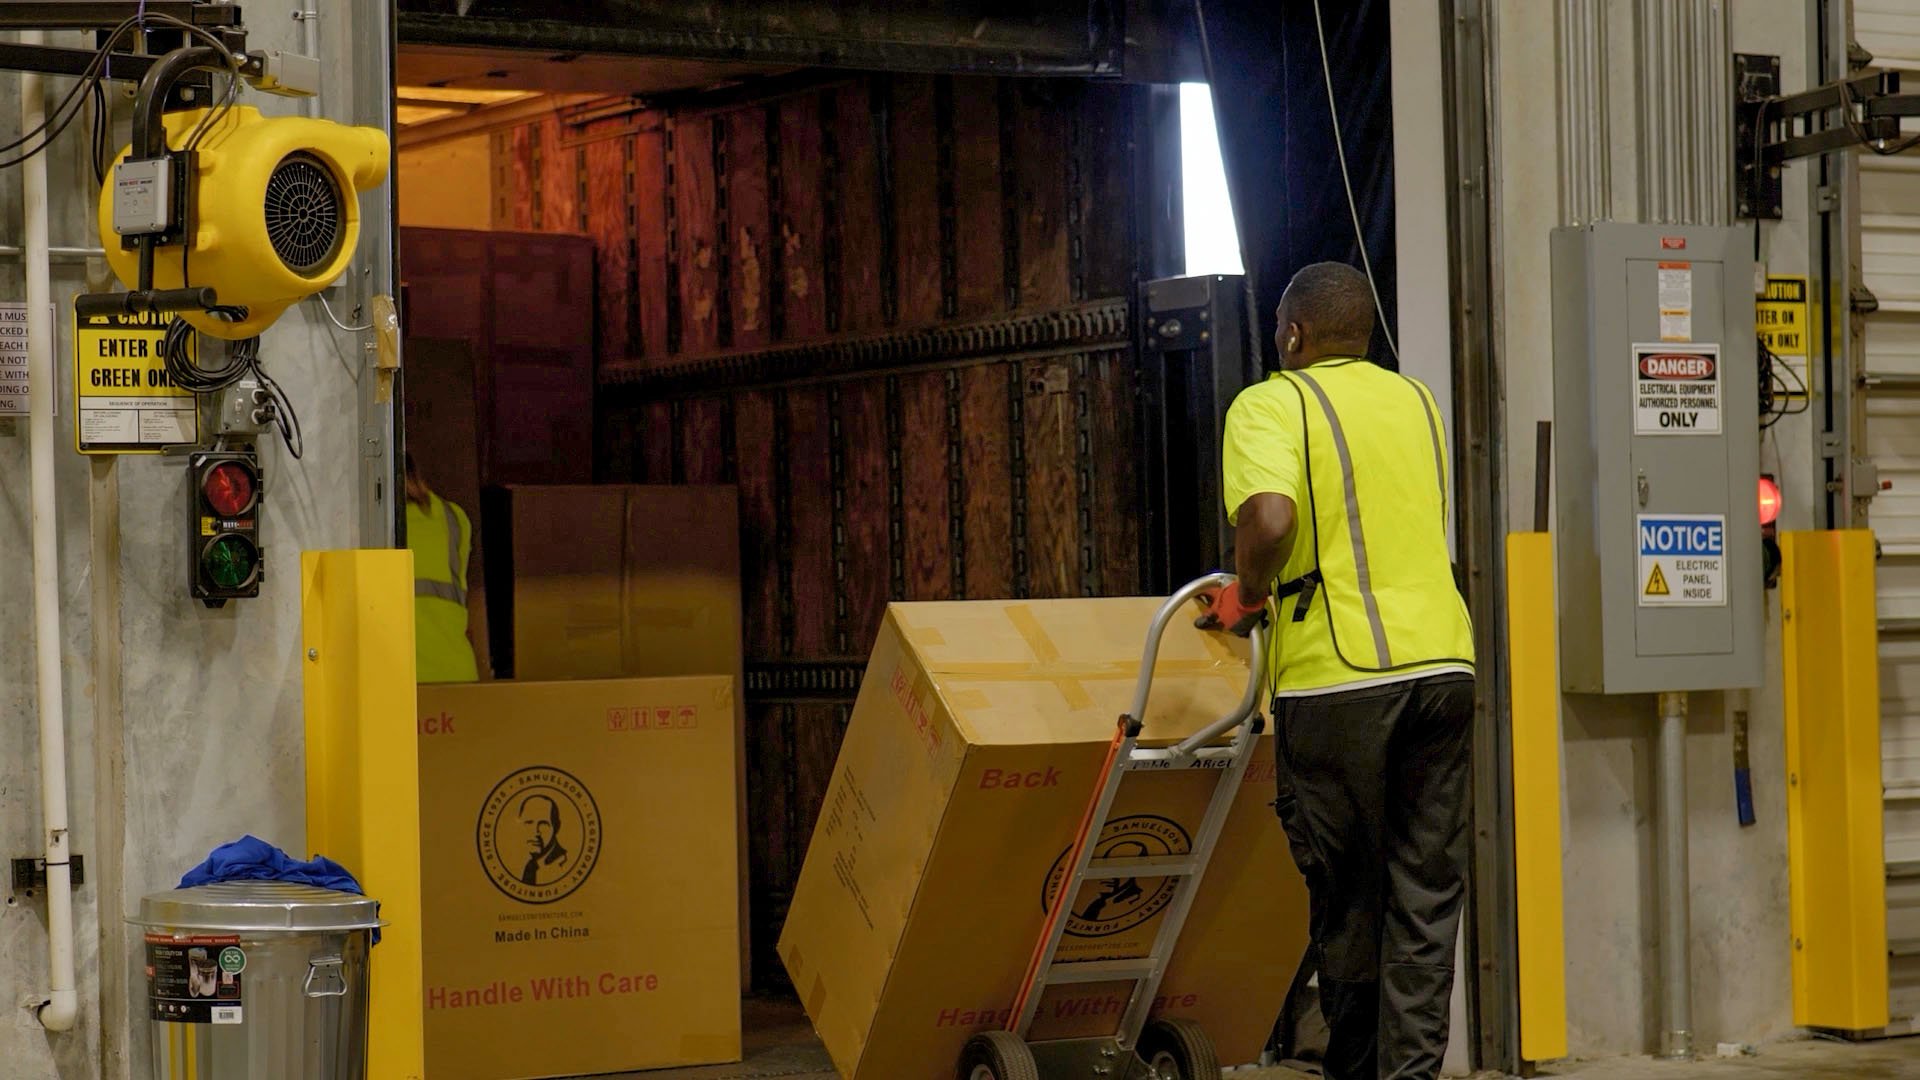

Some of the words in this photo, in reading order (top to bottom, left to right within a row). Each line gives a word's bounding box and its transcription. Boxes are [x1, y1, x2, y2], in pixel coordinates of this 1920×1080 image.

[1767, 281, 1800, 300] UTION
[4, 312, 27, 321] MUS
[117, 311, 177, 325] CAUTIO
[1782, 310, 1794, 324] ON
[98, 338, 148, 357] ENTER
[1778, 333, 1800, 348] ONLY
[7, 356, 26, 365] NOT
[1647, 359, 1708, 376] DANGER
[91, 368, 141, 387] GREEN
[148, 368, 177, 387] ONL
[1639, 383, 1677, 395] ELECTRICAL
[1679, 383, 1716, 396] EQUIPMENT
[1639, 397, 1678, 408] AUTHORIZED
[1680, 397, 1717, 409] PERSONNEL
[1659, 411, 1699, 428] ONLY
[1641, 525, 1722, 551] NOTICE
[1676, 560, 1719, 571] ELECTRIC
[1682, 574, 1712, 585] PANEL
[1683, 588, 1712, 599] INSIDE
[518, 773, 583, 800] SAMUELSON
[978, 766, 1062, 790] Back
[483, 823, 494, 861] SINCE
[1112, 821, 1181, 846] SAMUELSON
[572, 812, 597, 883] LEGENDARY
[497, 873, 559, 898] FURNITURE
[1138, 875, 1181, 918] ENDARY
[1066, 919, 1119, 932] FURNITU
[494, 929, 531, 943] Made
[534, 928, 547, 940] In
[550, 926, 590, 939] China
[428, 981, 523, 1010] Handle
[531, 974, 590, 1001] With
[598, 972, 659, 996] Care
[936, 1004, 1041, 1027] Hane
[1055, 995, 1121, 1018] With
[1153, 992, 1197, 1011] are
